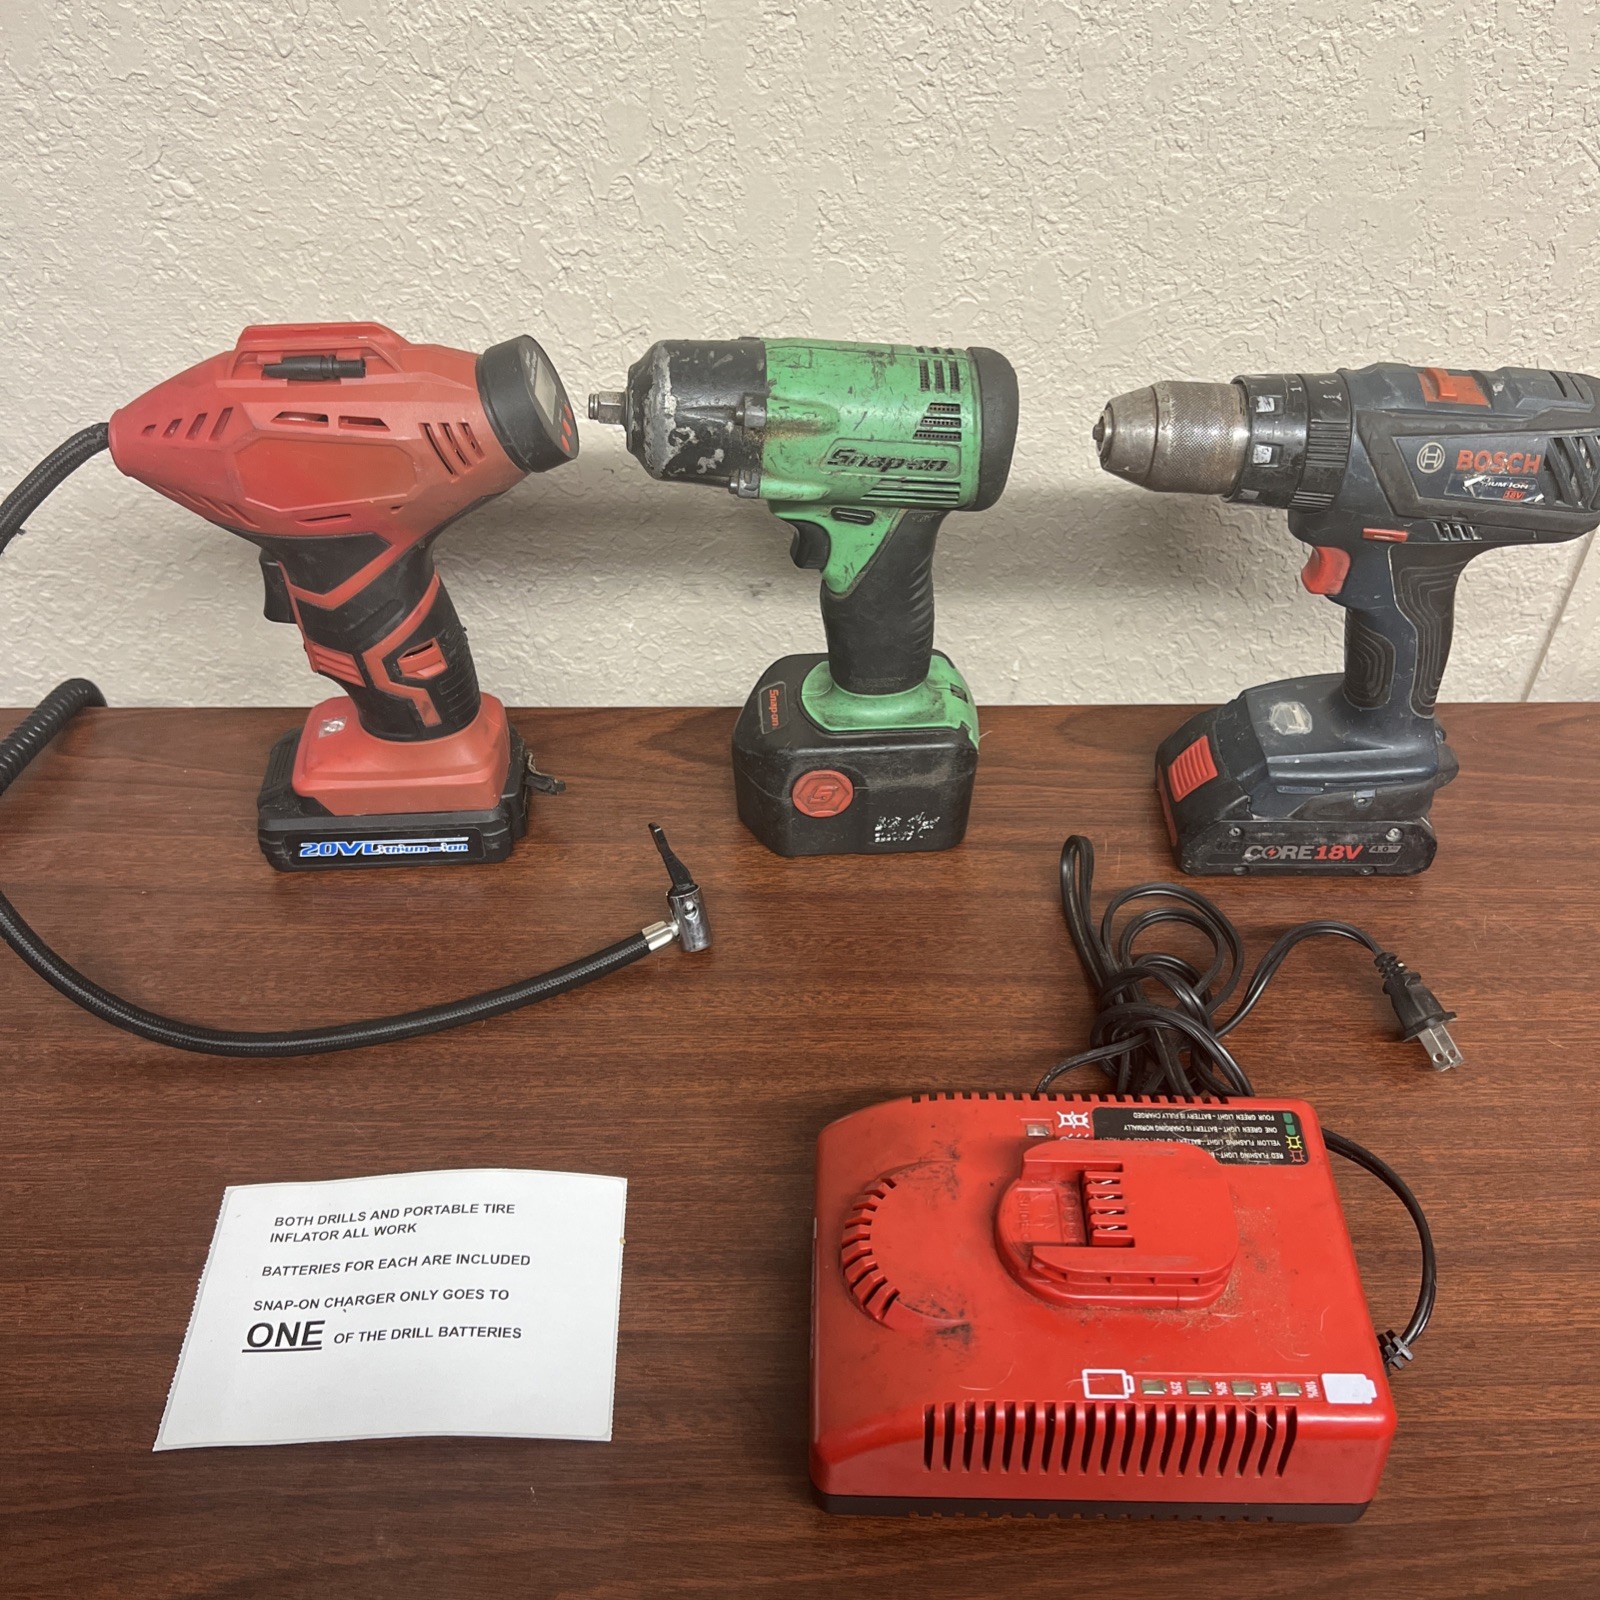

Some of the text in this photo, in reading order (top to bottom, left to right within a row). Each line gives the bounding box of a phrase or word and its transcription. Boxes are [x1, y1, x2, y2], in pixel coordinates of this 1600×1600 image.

[827, 448, 950, 473] Snap-on
[1456, 449, 1542, 474] BOSCH
[768, 689, 780, 727] Snap-on
[1187, 1112, 1212, 1120] BATTERY
[1235, 1113, 1256, 1121] GREEN
[1258, 1113, 1275, 1121] FOUR
[1123, 1124, 1154, 1132] NORMALLY
[1257, 1139, 1281, 1147] YELLOW
[1220, 1151, 1239, 1159] LIGHT
[274, 1203, 516, 1227] BOTH DRILLS AND PORTABLE TIRE
[269, 1223, 417, 1243] INFLATOR ALL WORK
[261, 1253, 531, 1277] BATTERIES FOR EACH ARE INCLUDED
[253, 1288, 510, 1312] SNAP-ON CHARGER ONLY GOES TO
[245, 1319, 522, 1349] ONE OF THE DRILL BATTERIES
[1169, 1381, 1183, 1396] 25%
